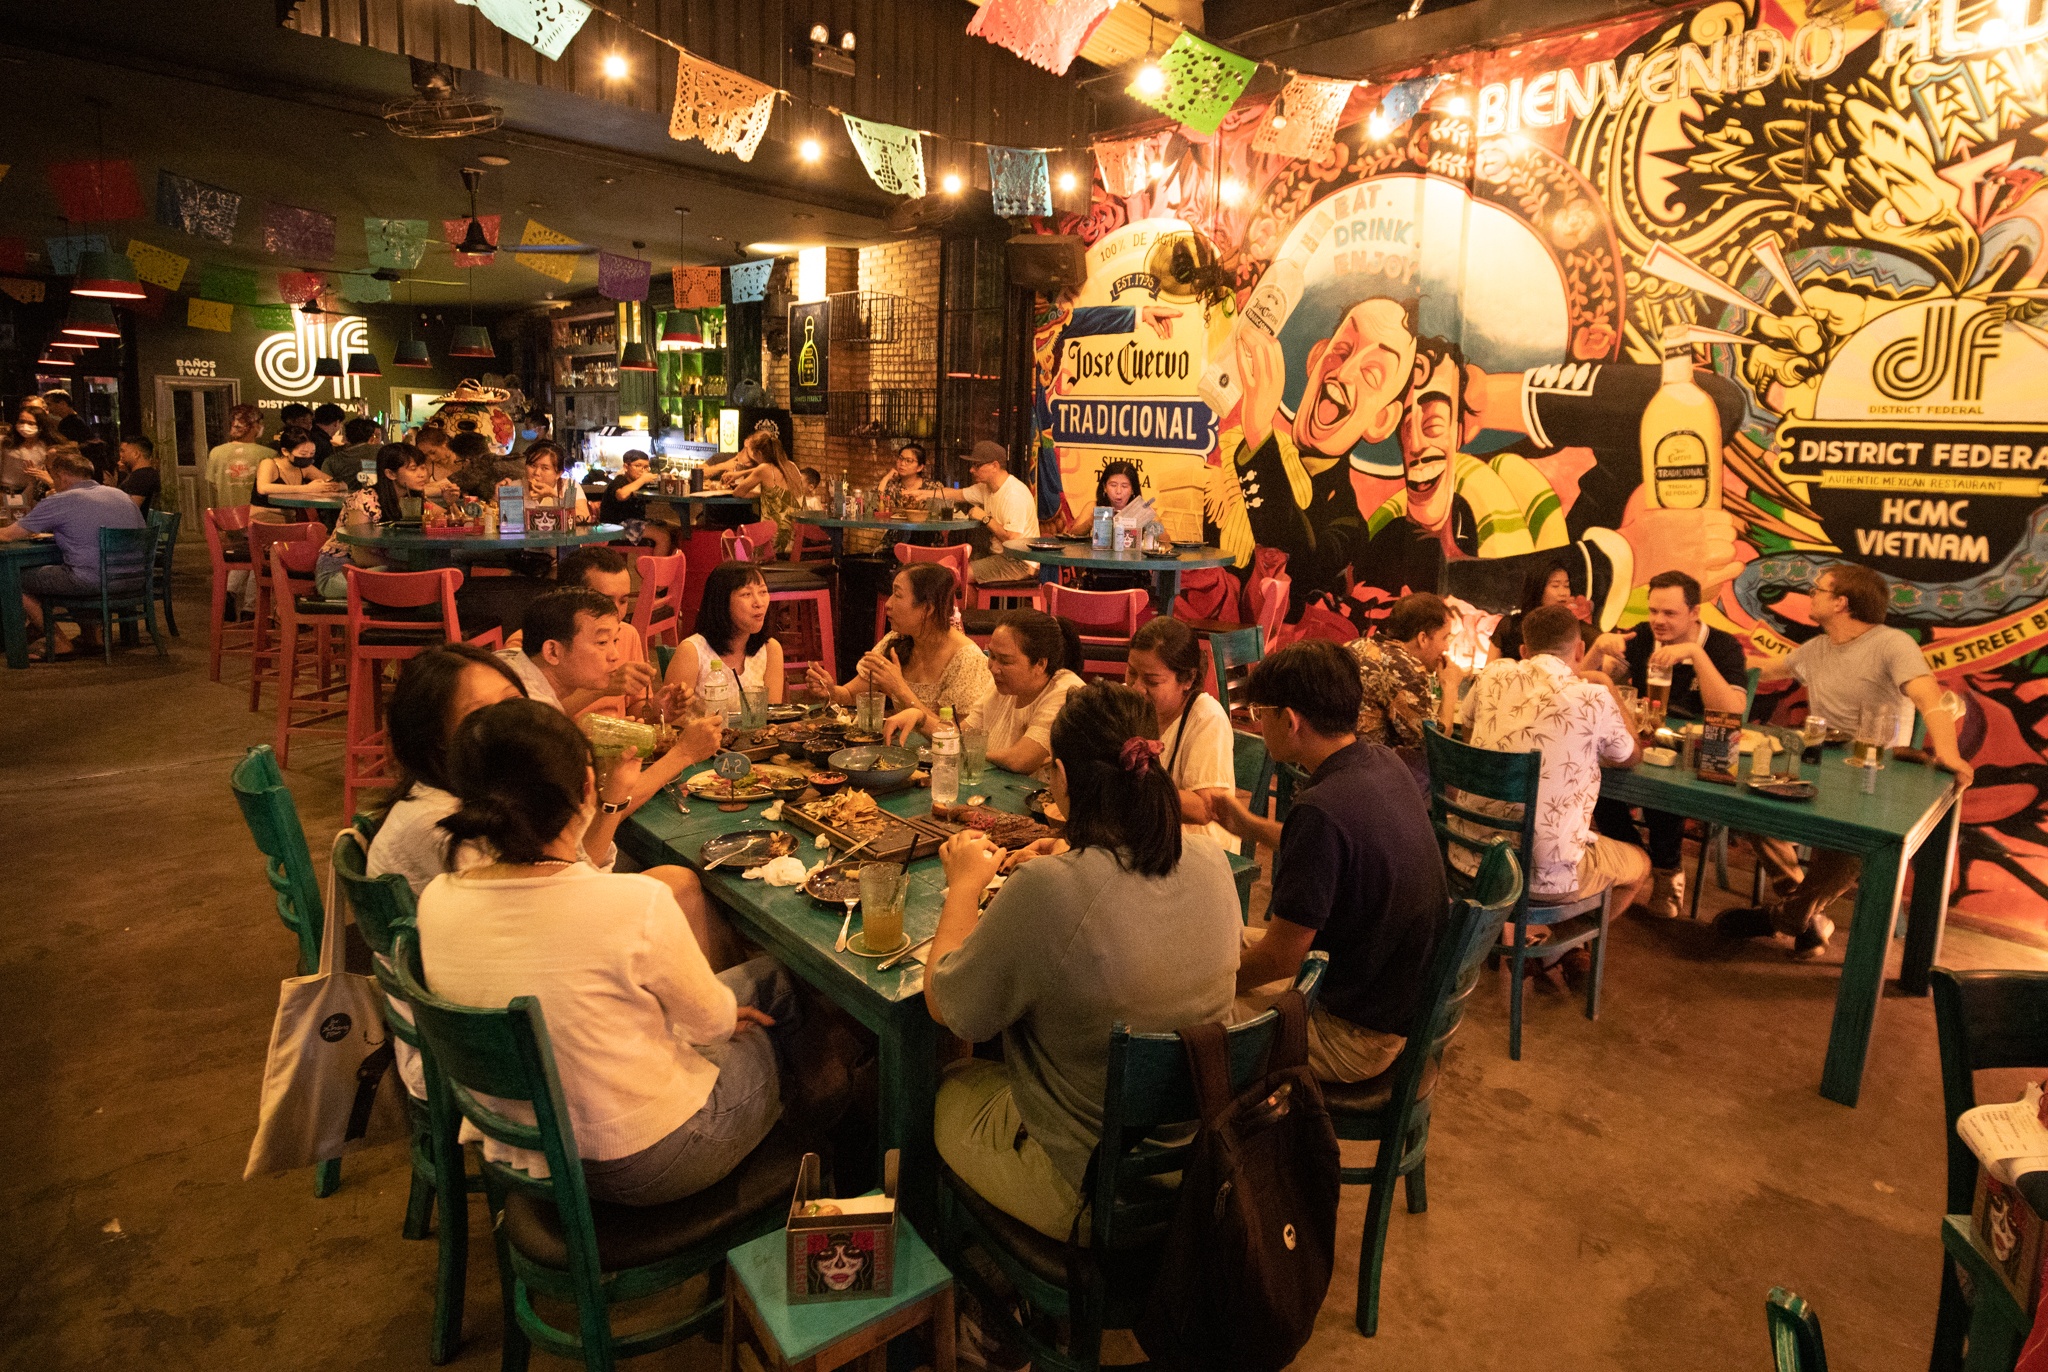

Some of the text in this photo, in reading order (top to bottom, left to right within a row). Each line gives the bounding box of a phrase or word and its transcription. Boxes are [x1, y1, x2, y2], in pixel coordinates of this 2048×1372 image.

[1476, 17, 1846, 137] BIENVENIDO
[1133, 232, 1147, 247] DE
[1067, 340, 1190, 386] Jose Cuervo
[1058, 403, 1197, 441] TRADICIONAL
[1868, 405, 1984, 415] DISTRICT FEDERAL
[1800, 440, 1924, 467] DISTRICT
[1828, 475, 2004, 491] AUTHENTIC MEXICAN RESTAURANT
[1881, 498, 1970, 528] HCMC
[1855, 528, 1990, 563] VIETNAM
[1953, 623, 2027, 662] STREET
